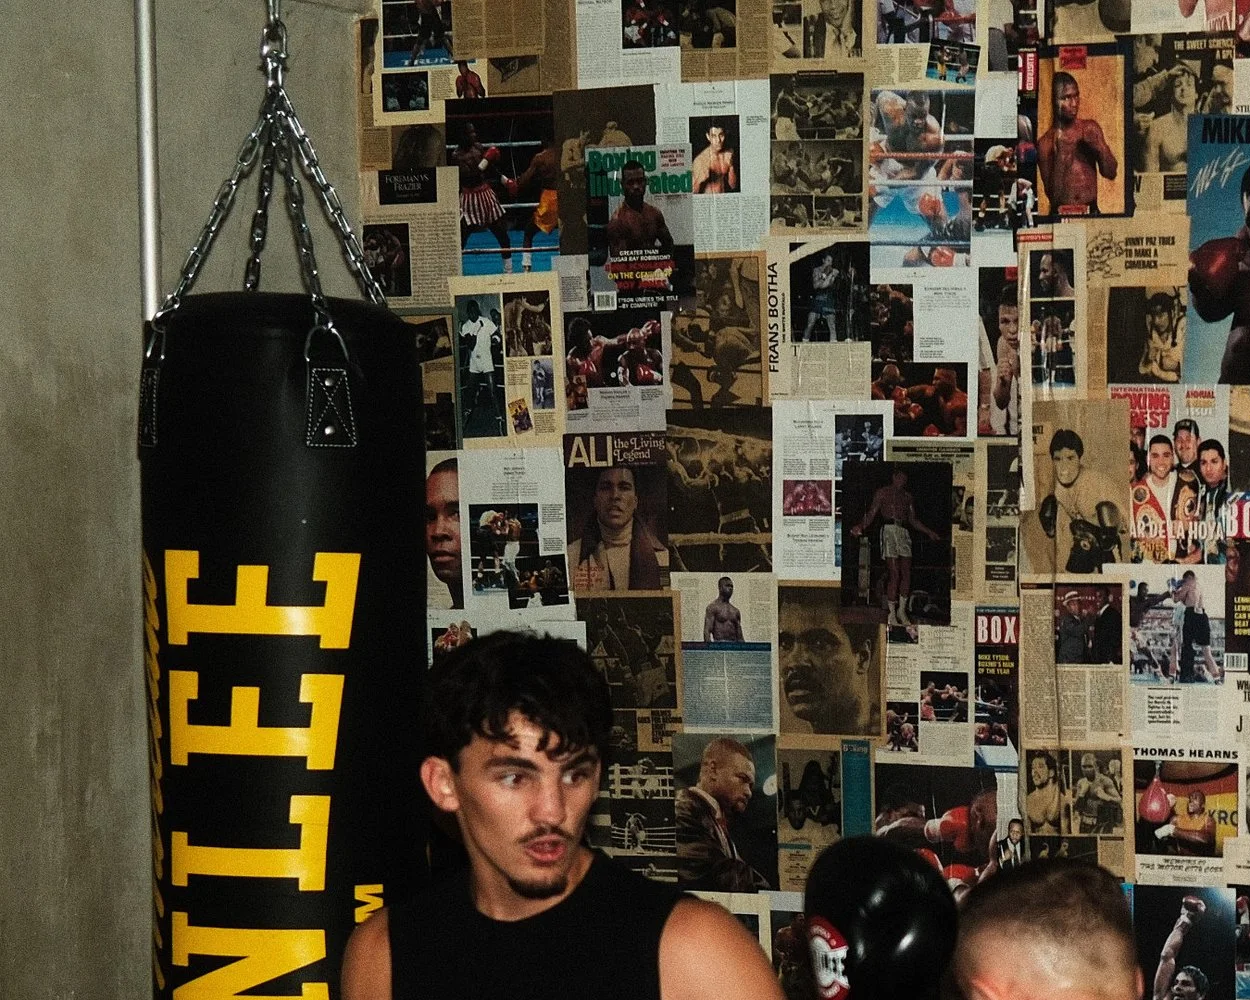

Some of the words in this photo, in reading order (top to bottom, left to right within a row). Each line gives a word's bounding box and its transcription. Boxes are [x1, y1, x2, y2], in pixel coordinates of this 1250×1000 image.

[608, 271, 618, 280] ON
[620, 271, 634, 279] THE
[767, 262, 778, 317] BOTHA
[768, 323, 779, 373] FRANS
[568, 435, 614, 468] ALI
[614, 439, 629, 449] the
[630, 437, 666, 451] Living
[613, 449, 651, 463] Legend
[1149, 520, 1166, 538] DE
[1167, 520, 1185, 539] LA
[1188, 520, 1224, 540] HOYA
[977, 615, 1016, 643] BOX
[1133, 747, 1185, 758] THOMAS
[1190, 749, 1239, 759] HEARNS
